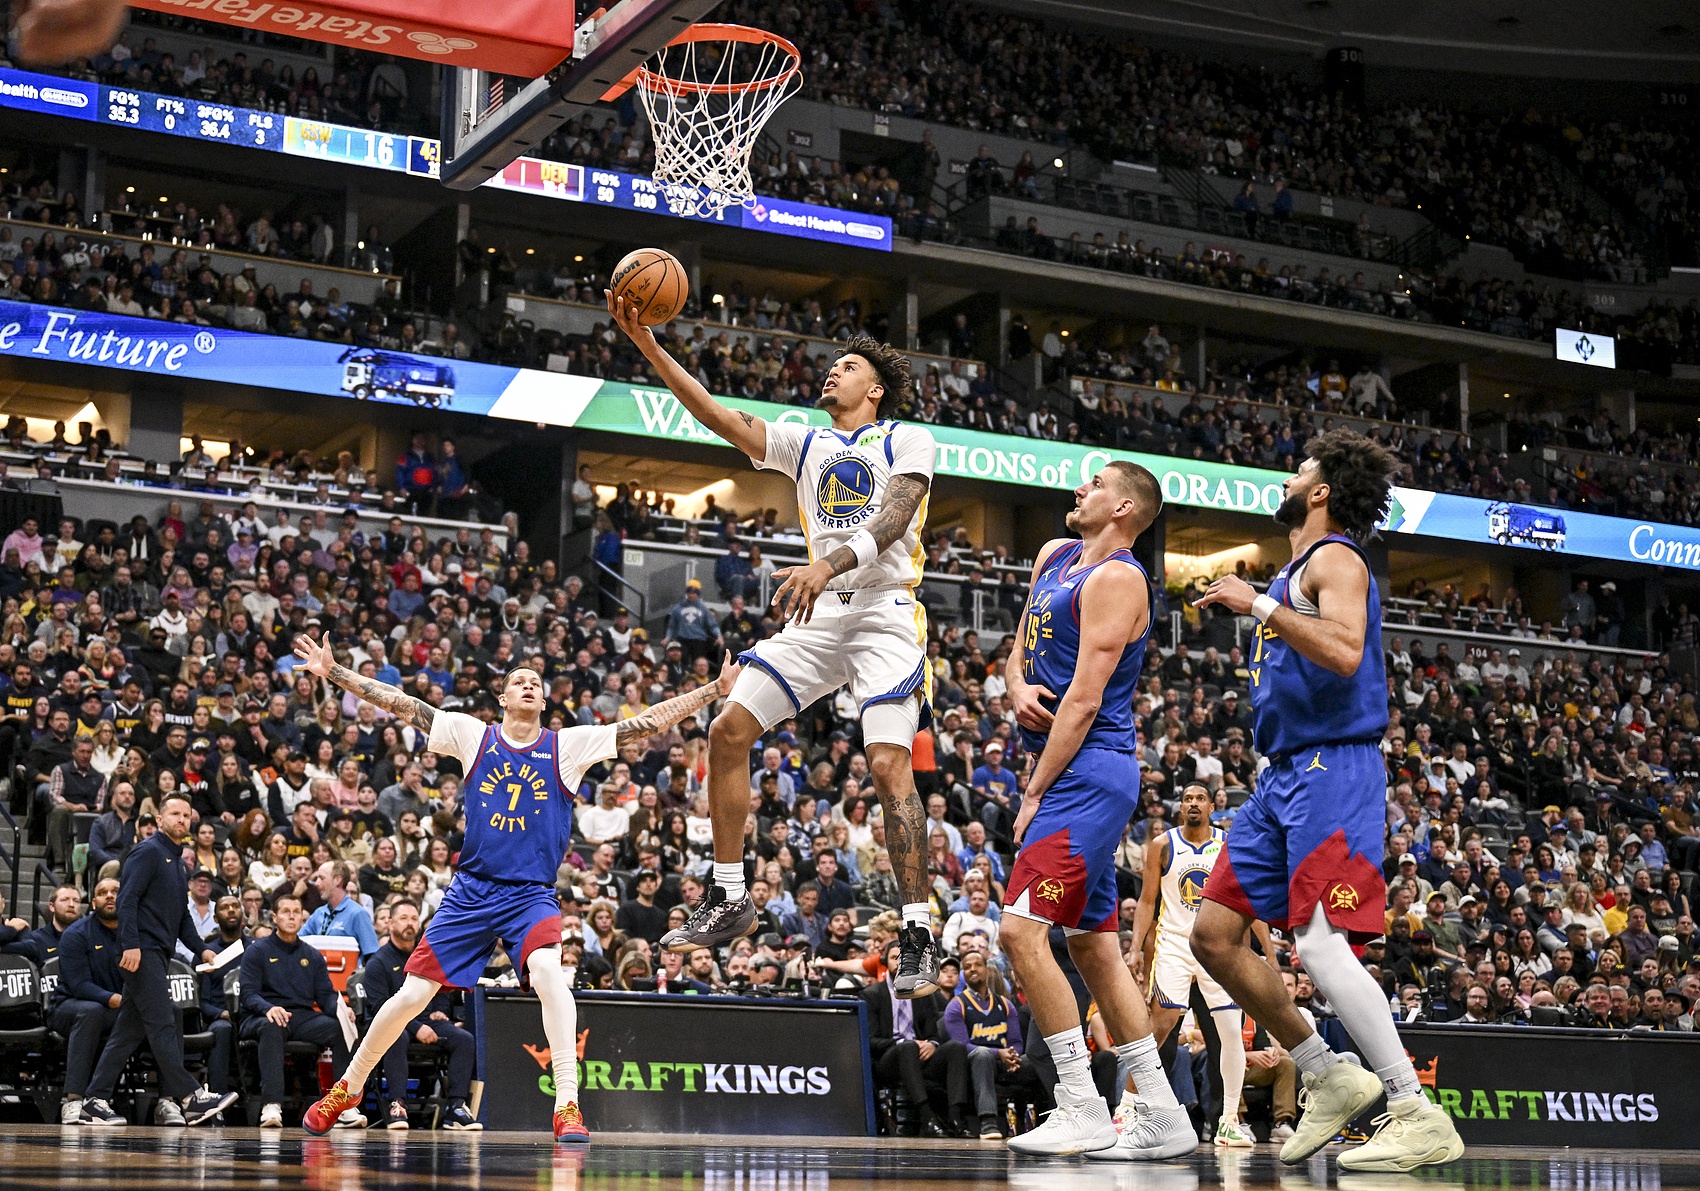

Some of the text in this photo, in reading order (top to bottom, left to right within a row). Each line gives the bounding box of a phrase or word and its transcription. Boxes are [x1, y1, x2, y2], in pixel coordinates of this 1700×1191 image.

[108, 90, 140, 107] FG%
[156, 98, 185, 115] FT%
[197, 105, 235, 123] 3FG%
[249, 114, 274, 129] FLS
[108, 105, 266, 145] 35.3 0 36.4 3
[364, 133, 394, 166] 16
[592, 171, 620, 188] FG%
[598, 188, 615, 203] 50
[633, 192, 657, 210] 100
[769, 209, 807, 228] Select
[808, 216, 846, 233] Health
[819, 450, 853, 470] GOLDEN
[1041, 459, 1073, 487] of
[816, 506, 875, 529] WARRIORS
[1025, 613, 1040, 651] 15
[1470, 647, 1488, 658] 104
[479, 762, 549, 800] MILE HIGH
[507, 783, 522, 811] 7
[489, 813, 526, 833] CITY
[1180, 899, 1200, 914] WARR
[40, 976, 59, 993] GET
